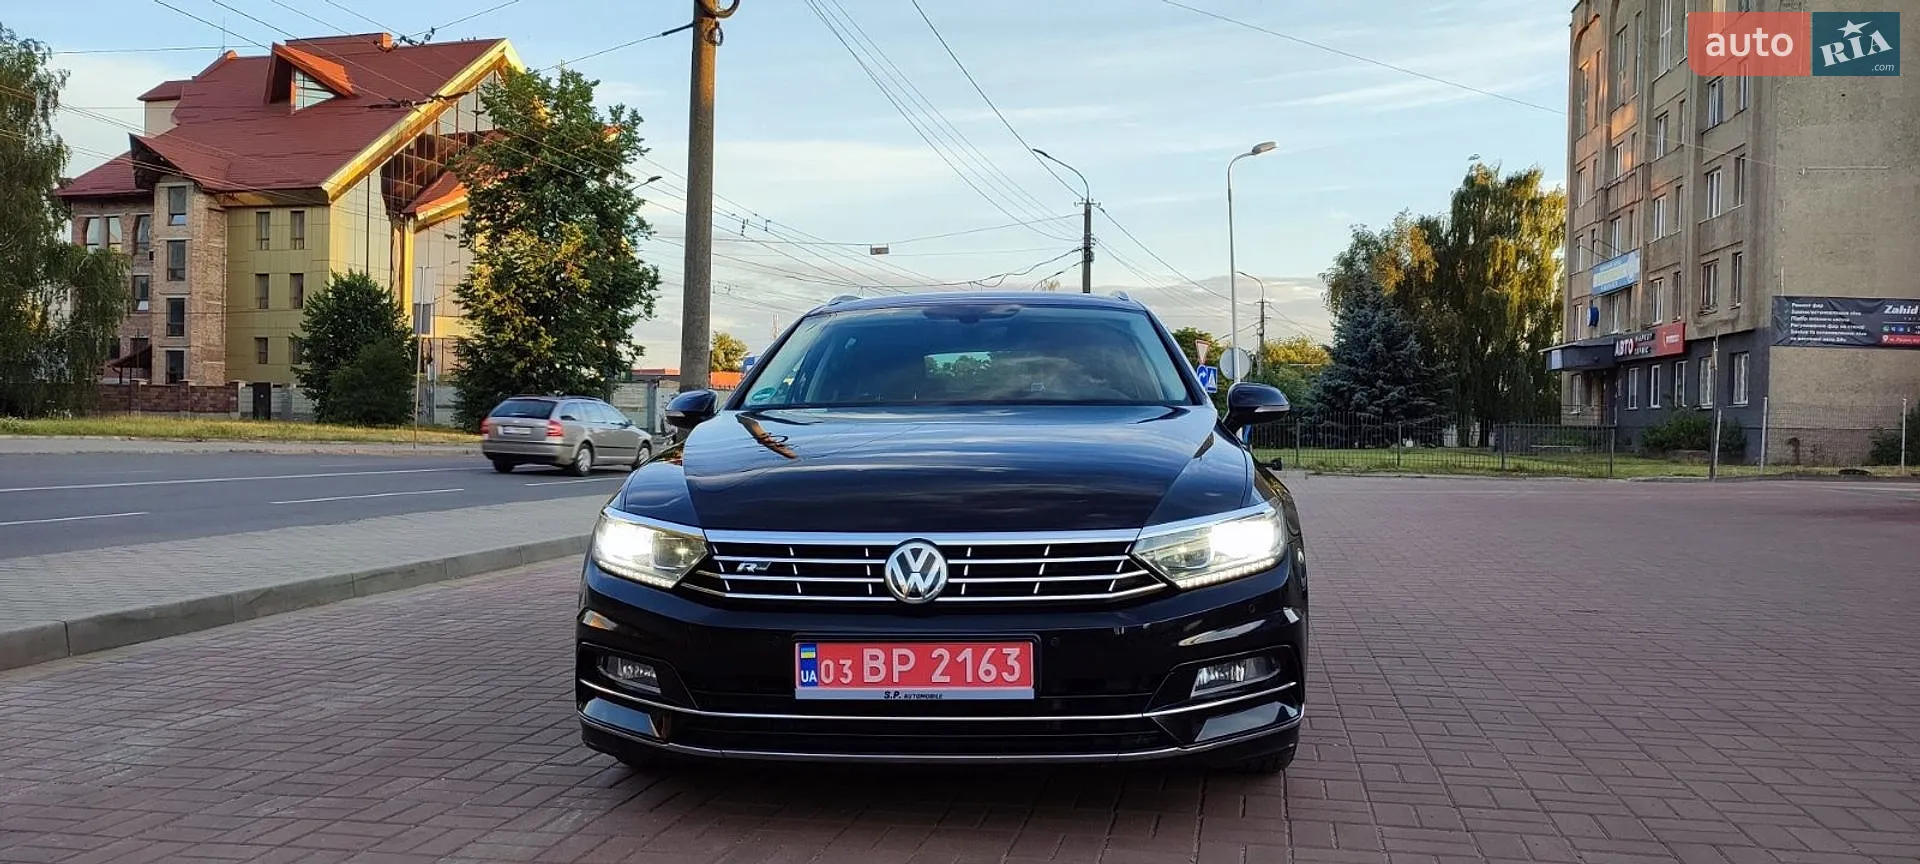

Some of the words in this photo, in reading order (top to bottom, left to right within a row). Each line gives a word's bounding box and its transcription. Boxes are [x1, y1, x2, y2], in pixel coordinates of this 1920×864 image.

[1883, 304, 1919, 314] Zahid
[1614, 338, 1634, 357] АВТО
[820, 659, 853, 684] 03
[863, 648, 916, 683] BP
[930, 648, 1022, 683] 2163
[800, 669, 818, 683] UA
[884, 691, 902, 699] S.P.
